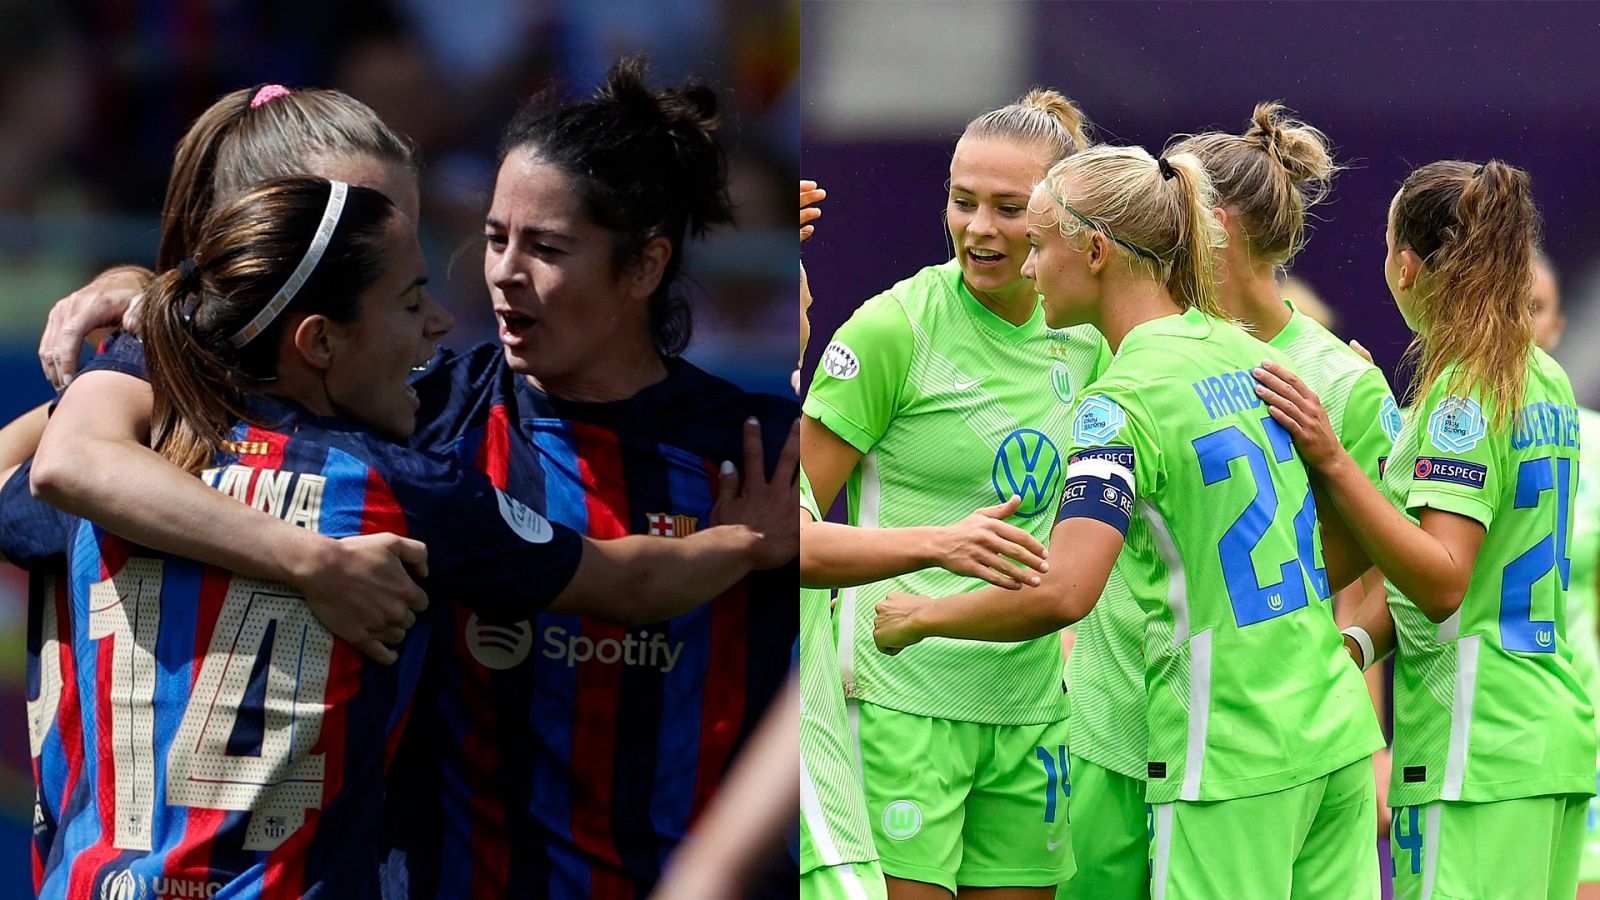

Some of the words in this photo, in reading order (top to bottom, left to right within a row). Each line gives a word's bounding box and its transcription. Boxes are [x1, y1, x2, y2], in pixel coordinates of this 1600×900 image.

[1192, 366, 1264, 420] HARD
[1432, 464, 1486, 482] RESPECT
[200, 464, 328, 534] ANA
[542, 625, 685, 673] Spotify
[88, 556, 334, 850] 14
[153, 875, 225, 898] UNHC
